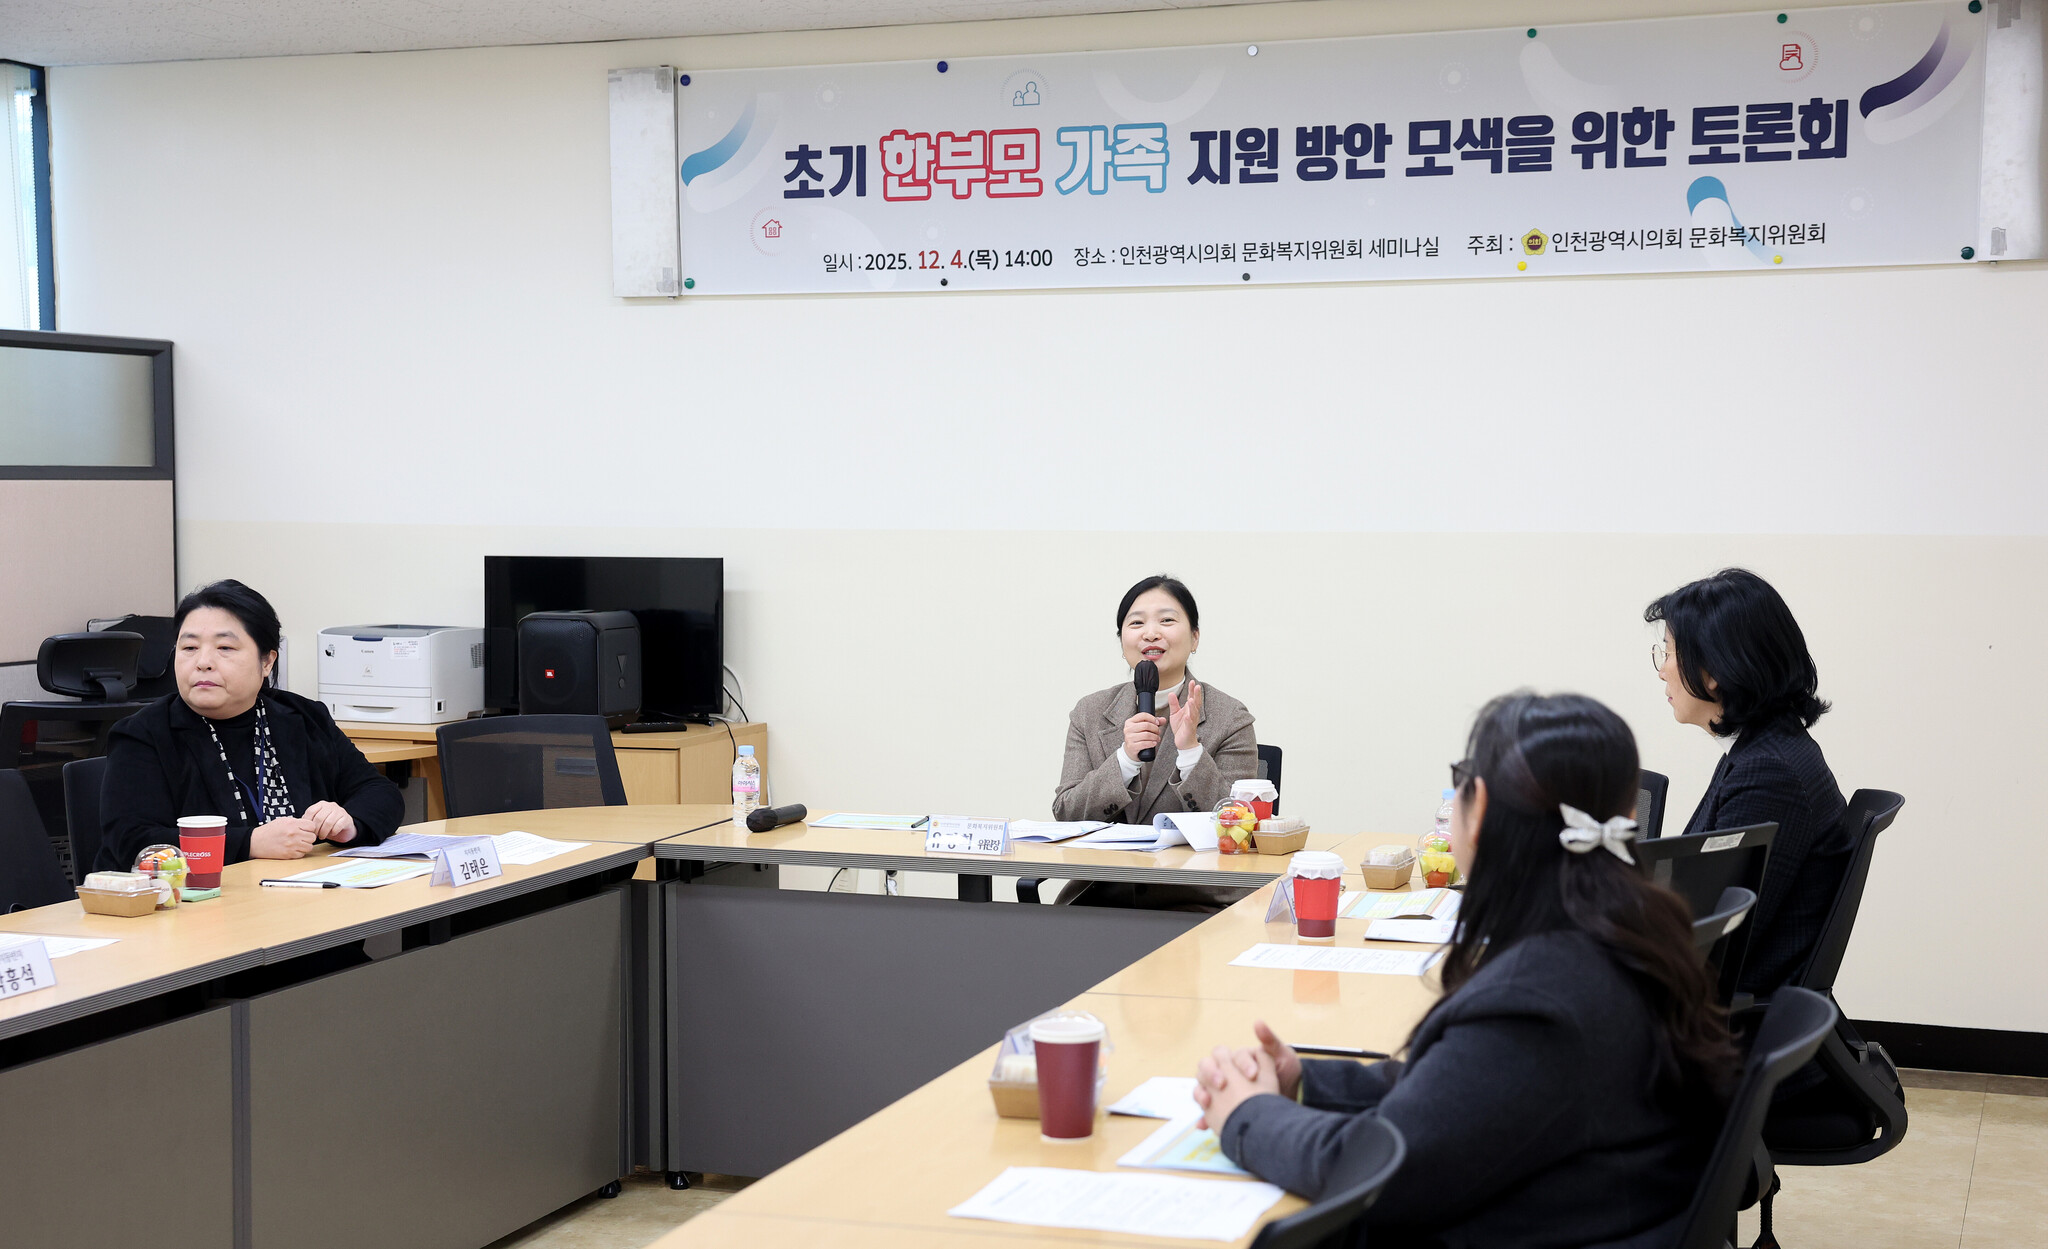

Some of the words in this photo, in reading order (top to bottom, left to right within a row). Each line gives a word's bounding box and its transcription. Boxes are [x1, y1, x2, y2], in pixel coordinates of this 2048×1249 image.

[783, 144, 867, 200] 초기
[880, 128, 1043, 202] 한부모
[1055, 122, 1169, 195] 가족
[1187, 128, 1279, 186] 지원
[1296, 122, 1393, 181] 방안
[1405, 115, 1556, 177] 모색을
[1570, 105, 1676, 170] 위한
[1688, 98, 1849, 167] 토론회
[1074, 246, 1107, 267] 장소
[1119, 243, 1236, 266] 인천광역시의회
[1242, 238, 1362, 263] 문화복지위원회
[1368, 236, 1439, 258] 세미나실
[1467, 234, 1503, 256] 주최
[1551, 228, 1683, 253] 인천광역시의회
[1689, 222, 1826, 248] 문화복지위원회
[823, 253, 853, 273] 일시
[865, 253, 912, 271] 2025.
[918, 250, 945, 270] 12.
[950, 249, 999, 271] 4.(목)
[1005, 249, 1053, 268] 14:00
[978, 839, 1000, 851] 위원장
[460, 858, 490, 880] 김태은
